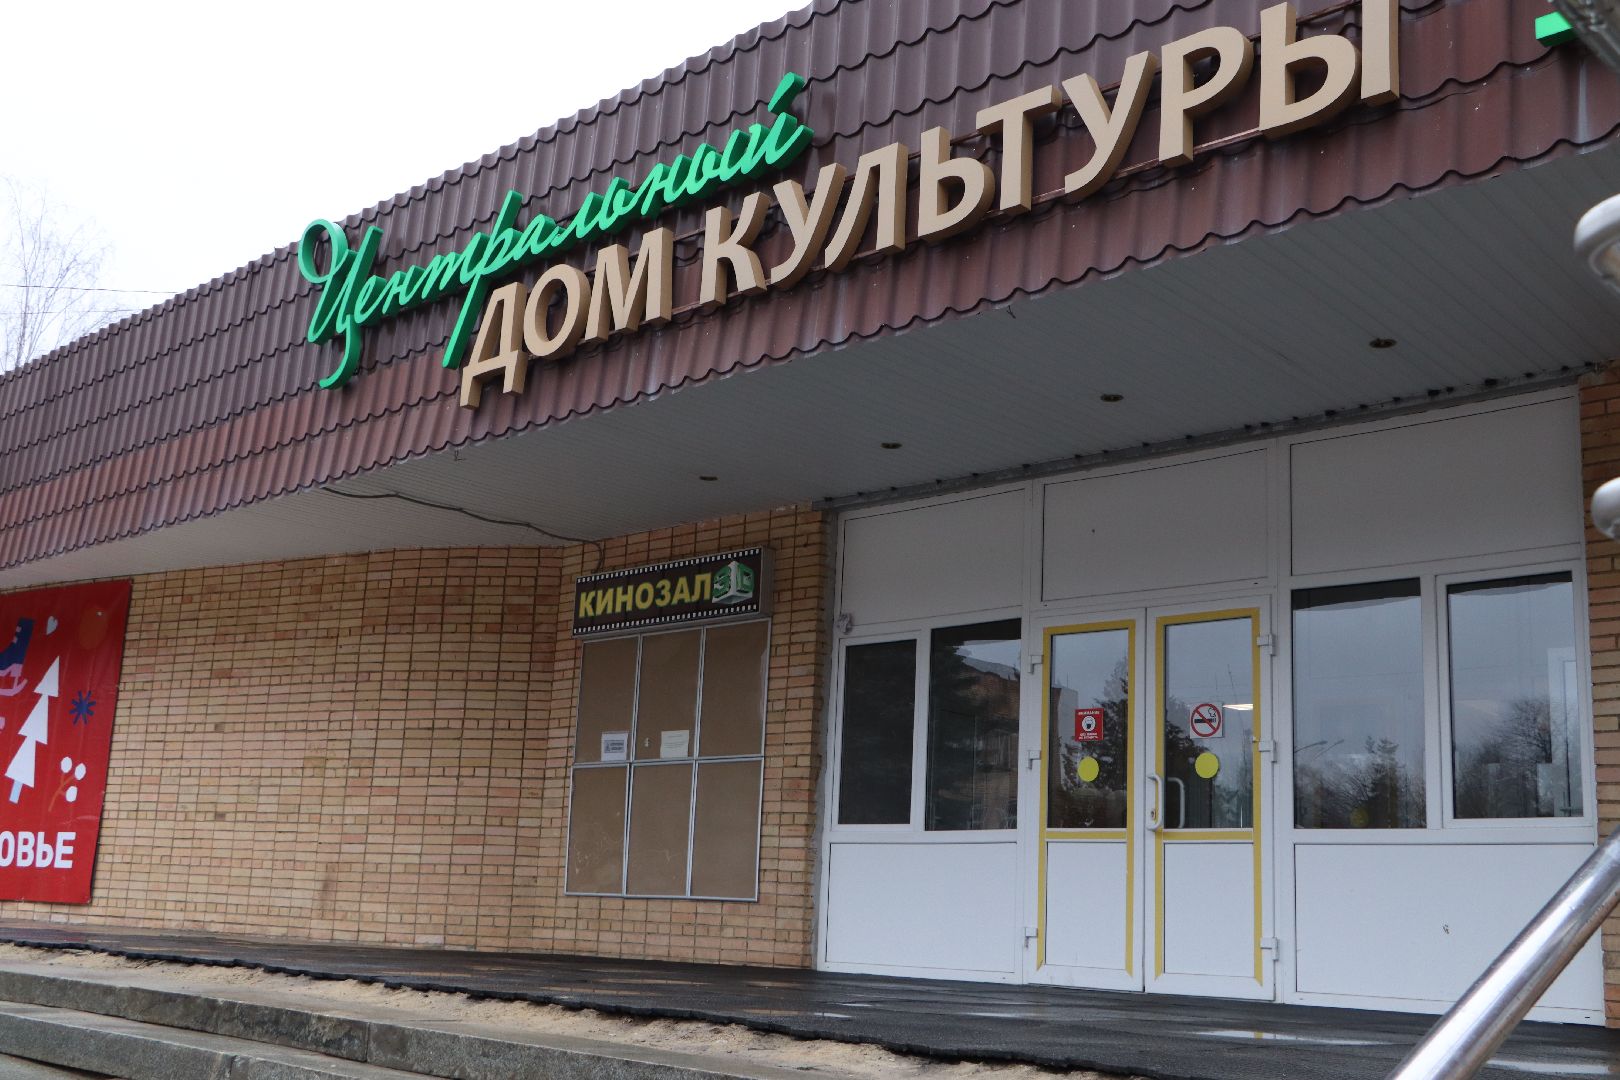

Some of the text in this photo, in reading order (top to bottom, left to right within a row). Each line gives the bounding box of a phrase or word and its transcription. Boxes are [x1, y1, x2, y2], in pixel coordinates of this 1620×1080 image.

[297, 72, 814, 390] Центральный
[459, 0, 1400, 410] ДОМ КУЛЬТУРЫ
[578, 572, 712, 618] КИНОЗАЛ
[0, 830, 77, 869] ОВЬЕ
